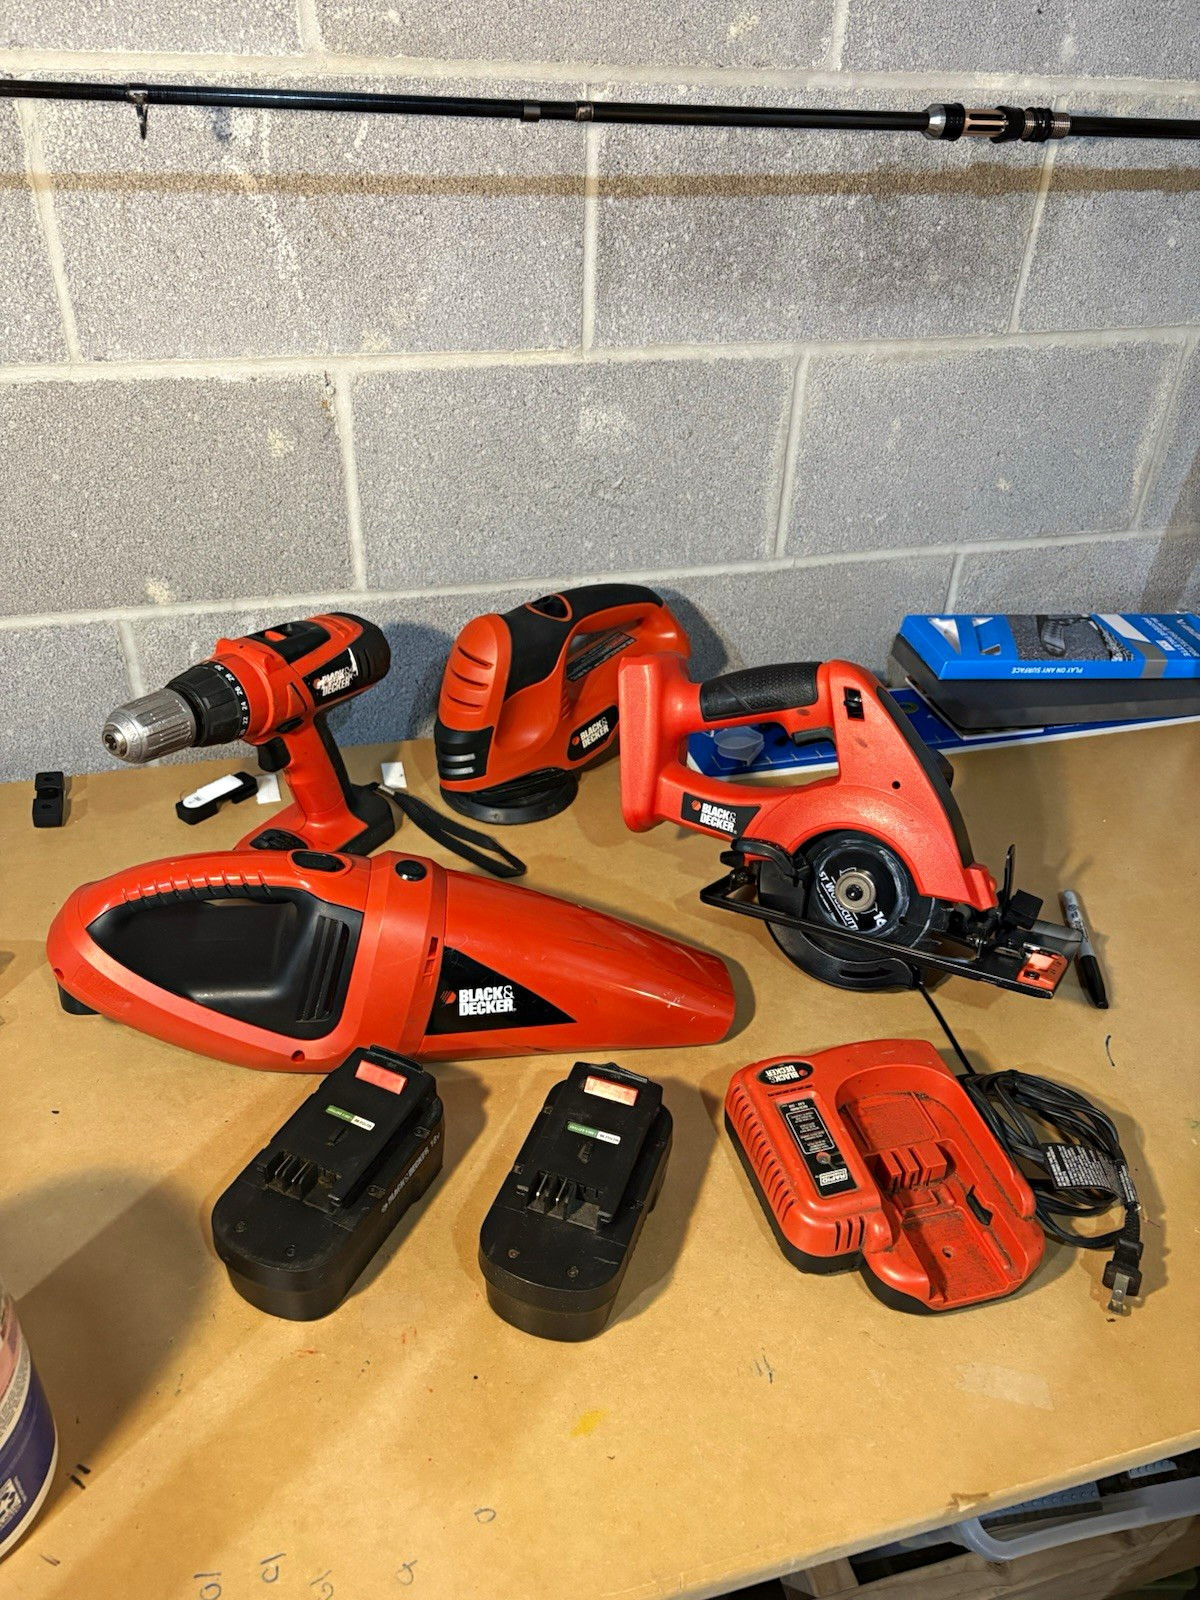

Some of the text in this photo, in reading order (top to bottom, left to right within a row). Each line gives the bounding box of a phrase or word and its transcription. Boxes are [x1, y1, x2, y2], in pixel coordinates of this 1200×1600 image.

[1011, 666, 1084, 674] PLAY ON ANY SURFACE
[240, 701, 248, 711] 24
[581, 724, 610, 749] DECKER
[700, 812, 735, 833] DECKER
[458, 998, 515, 1017] DECKER
[765, 1064, 796, 1077] DECKER
